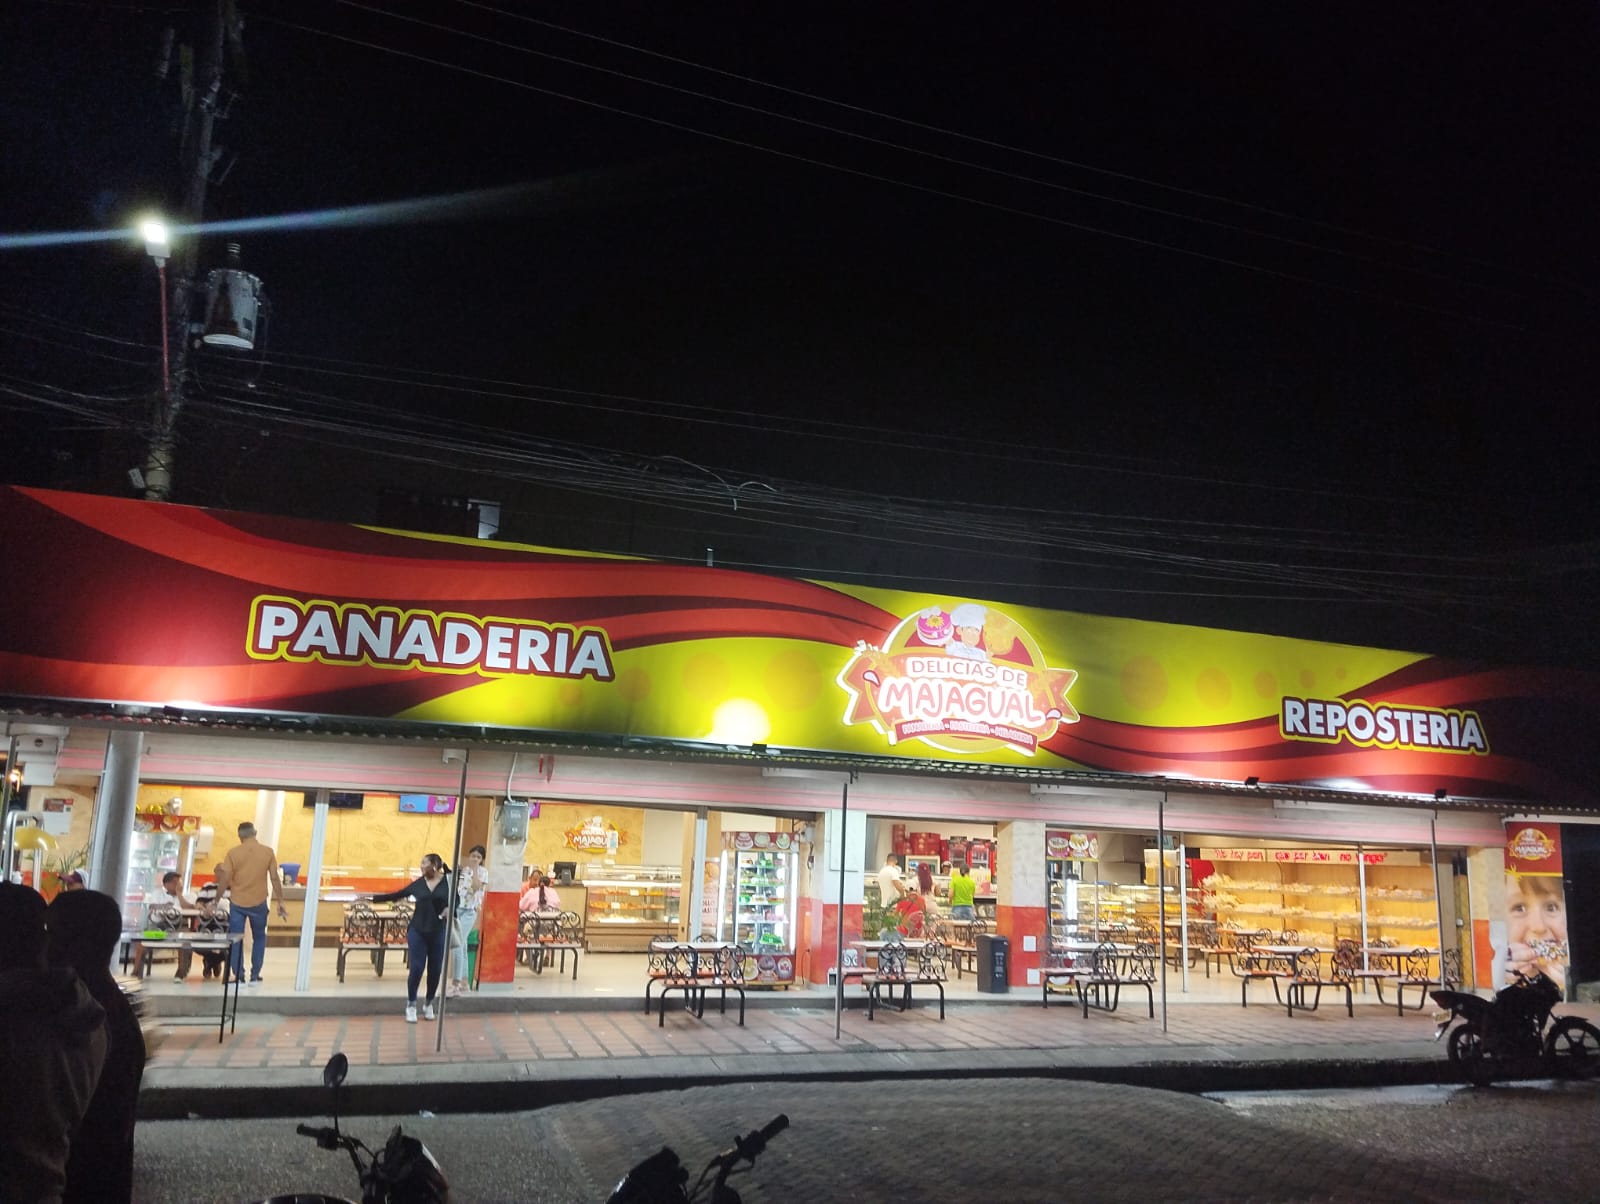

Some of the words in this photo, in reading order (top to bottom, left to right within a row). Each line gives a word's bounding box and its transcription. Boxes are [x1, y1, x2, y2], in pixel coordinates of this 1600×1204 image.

[256, 604, 611, 678] PANADERIA
[911, 659, 996, 679] DELICIAS
[1002, 669, 1026, 686] DE
[884, 682, 1043, 723] MAJAGUAL
[1283, 699, 1485, 749] REPOSTERIA
